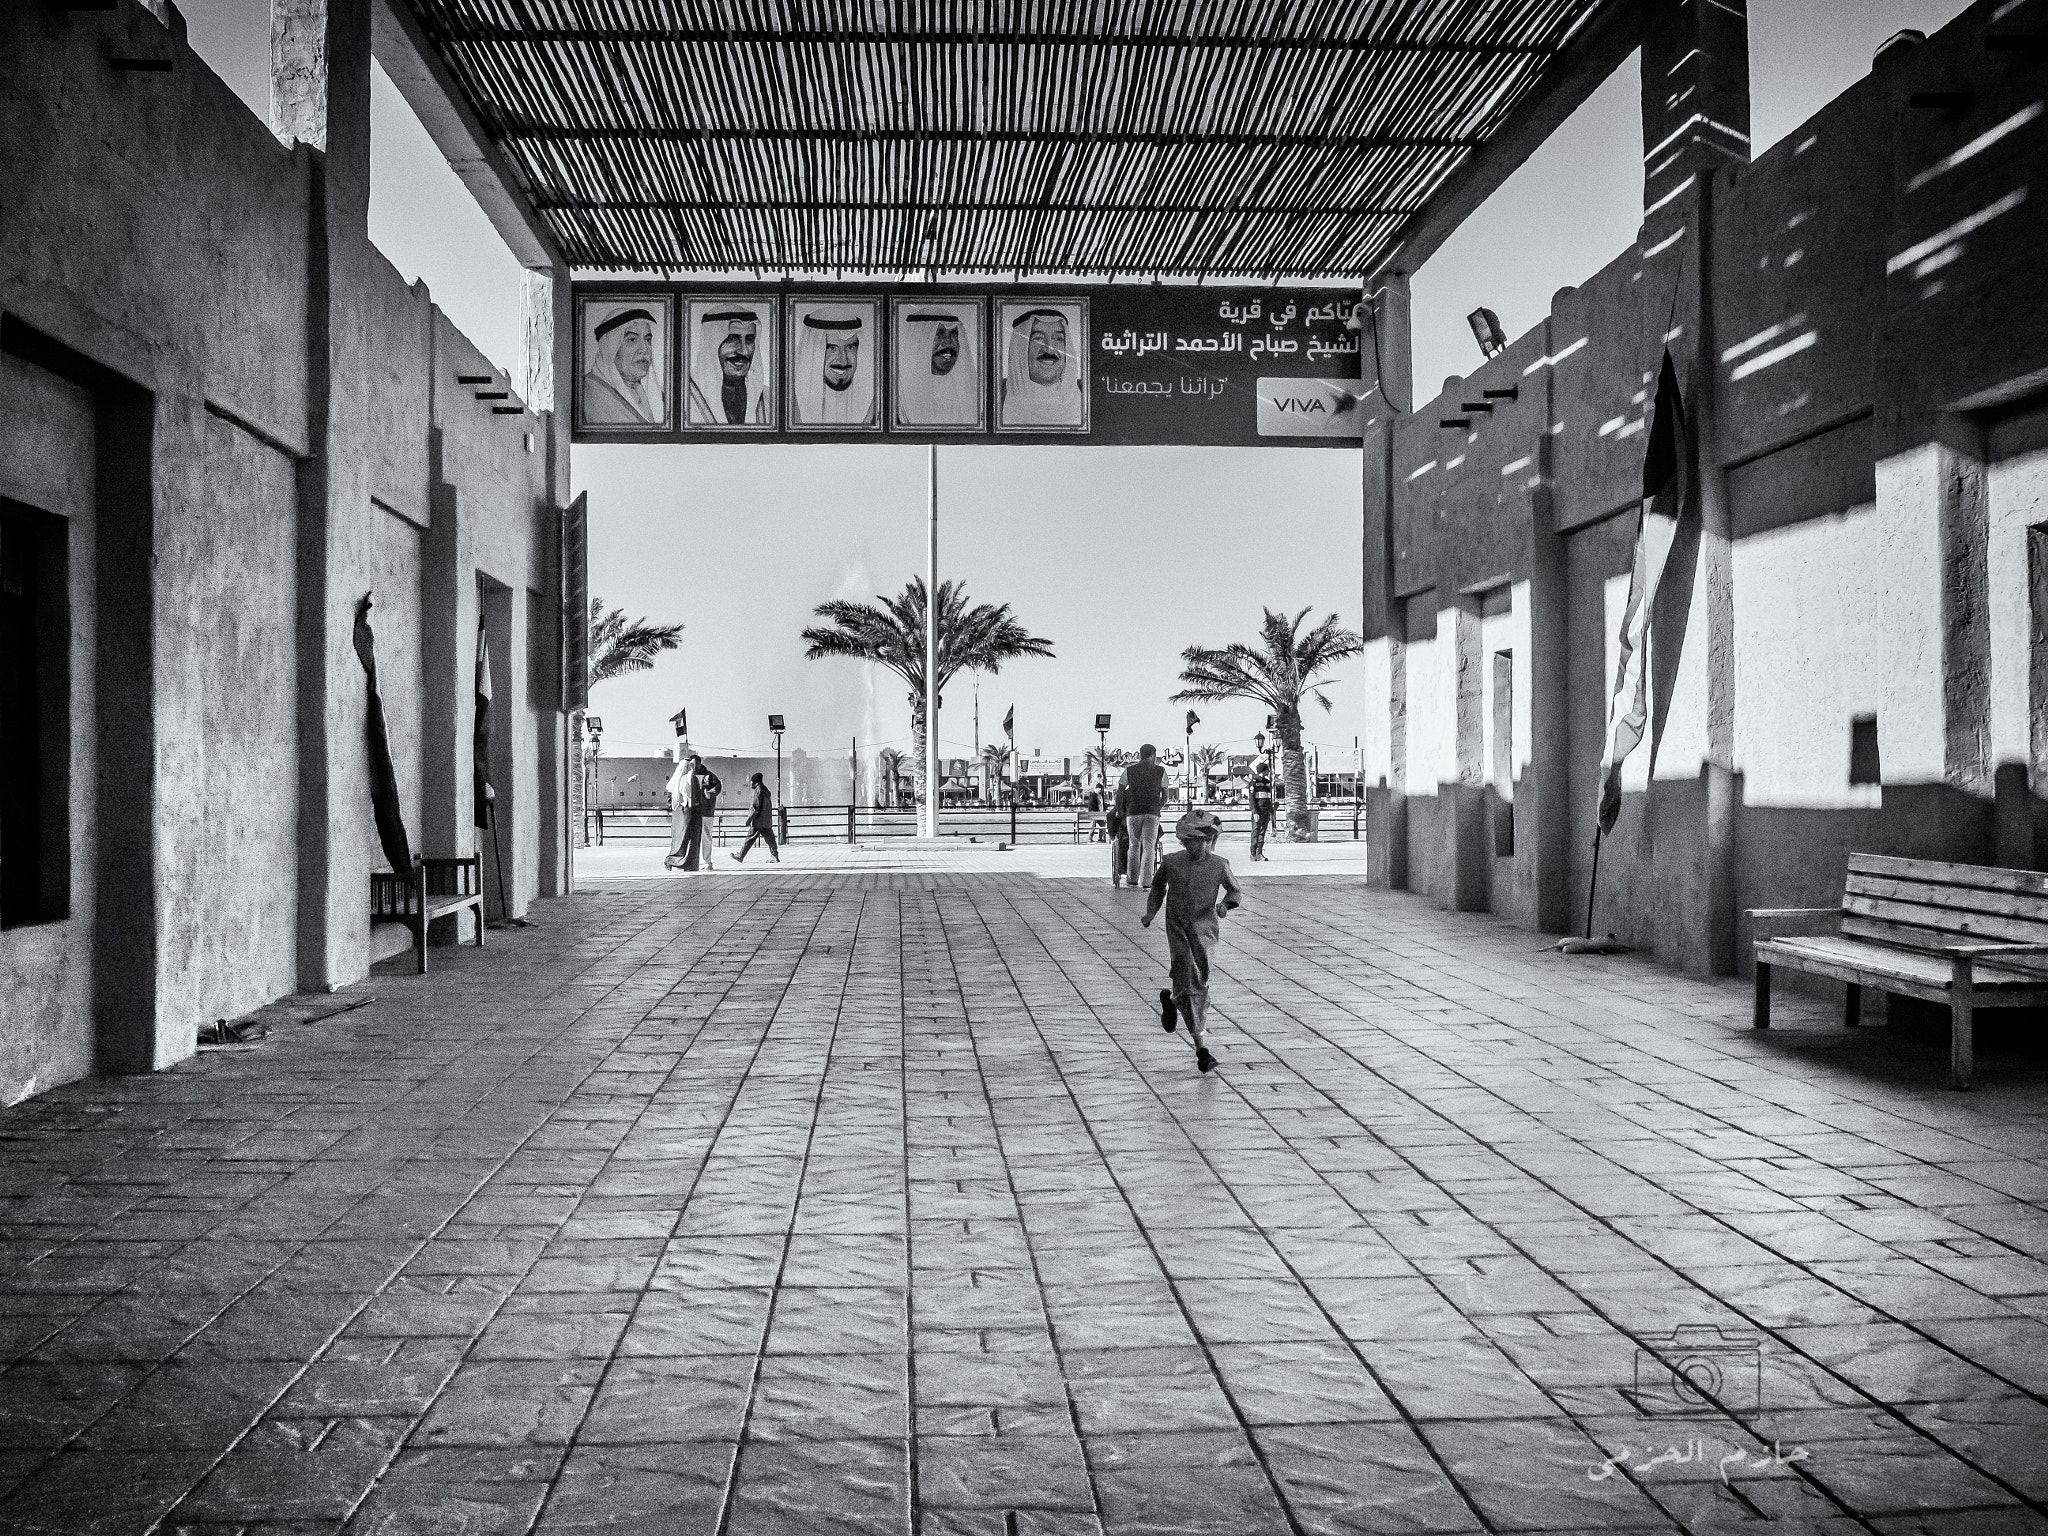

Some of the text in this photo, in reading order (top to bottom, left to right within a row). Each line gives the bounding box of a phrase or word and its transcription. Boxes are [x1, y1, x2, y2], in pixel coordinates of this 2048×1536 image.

[1218, 299, 1262, 327] قرية
[1269, 299, 1297, 330] في
[1101, 329, 1359, 362] لشيخ صباح الأحمد التراثية
[1273, 398, 1327, 413] VIVA
